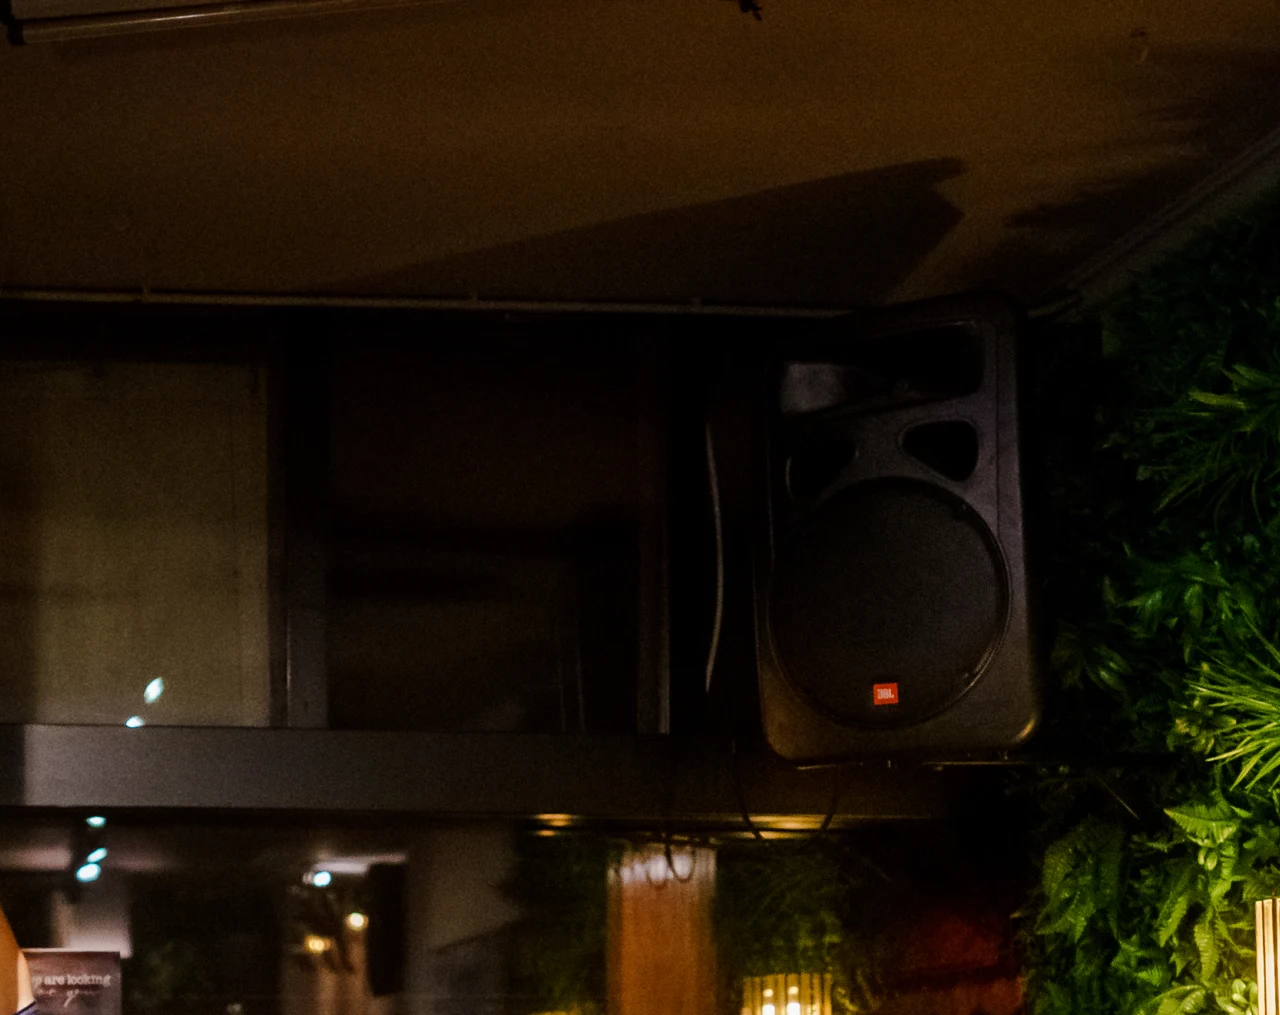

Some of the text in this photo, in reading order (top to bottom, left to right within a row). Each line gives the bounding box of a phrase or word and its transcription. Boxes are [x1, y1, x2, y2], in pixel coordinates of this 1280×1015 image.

[877, 688, 895, 700] JBL
[44, 974, 64, 985] are
[67, 973, 111, 986] looking
